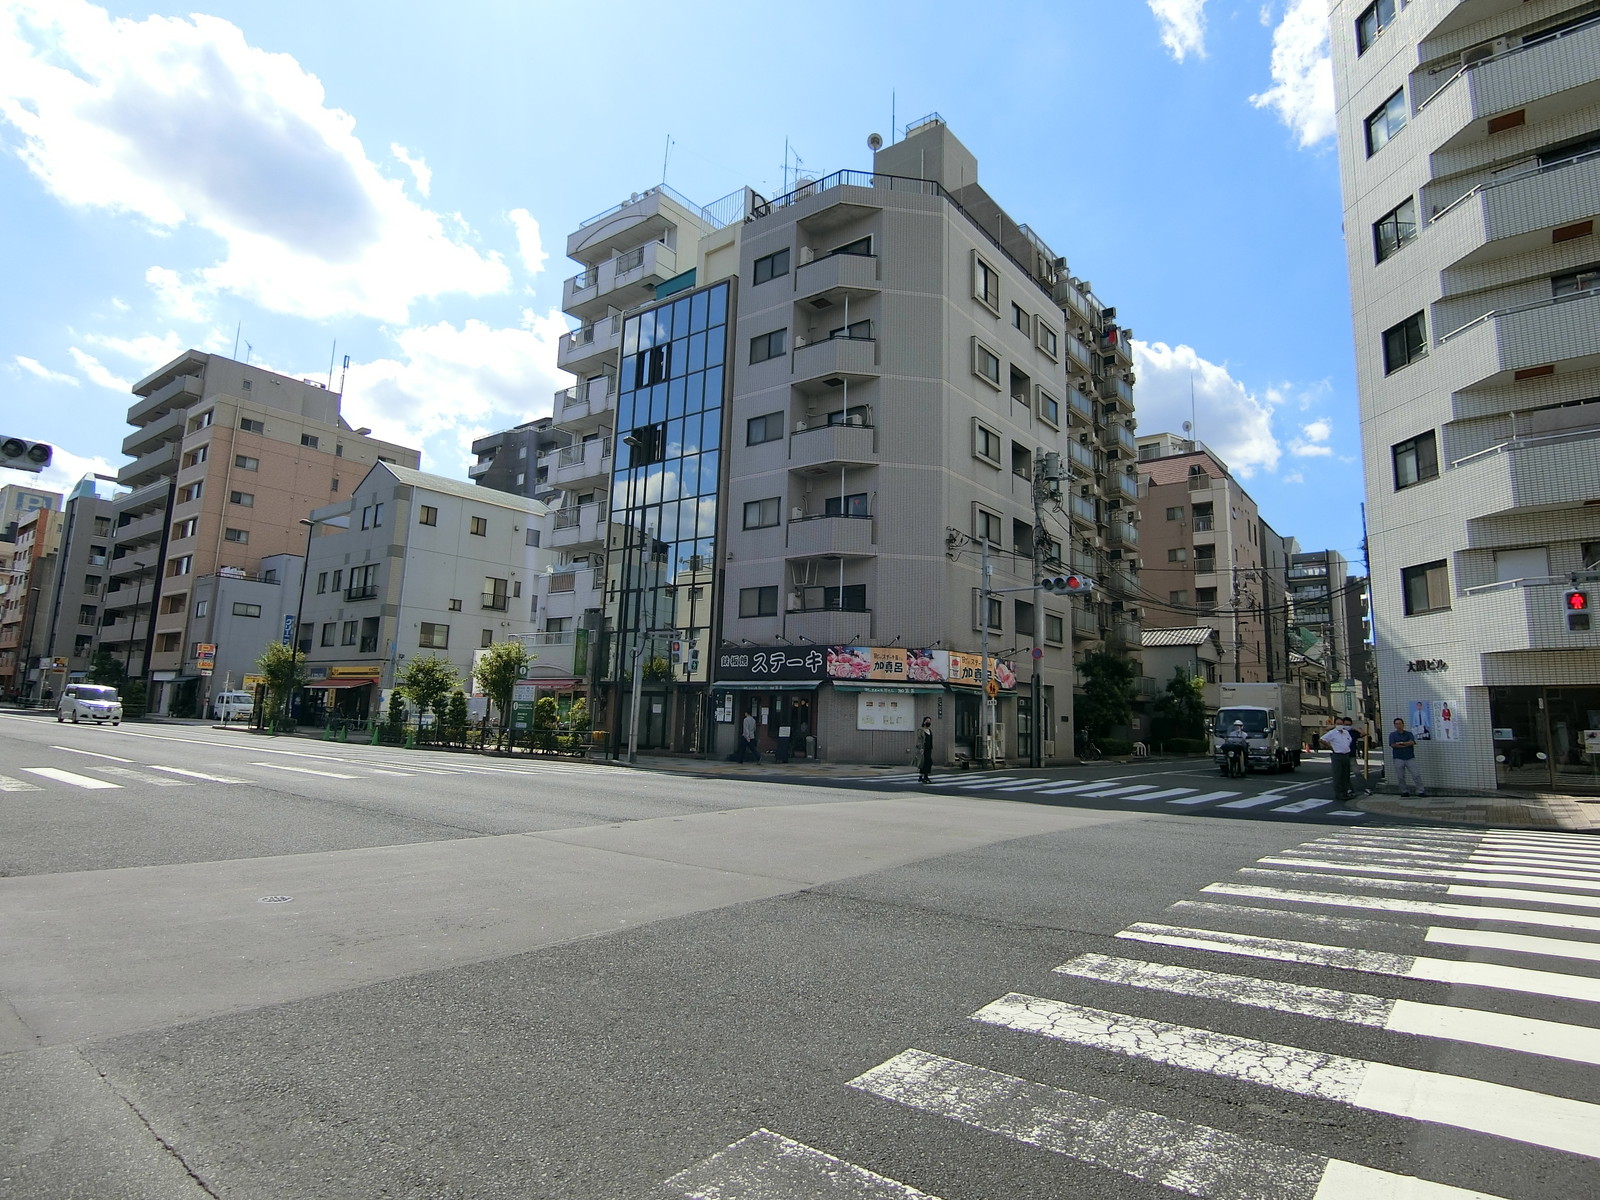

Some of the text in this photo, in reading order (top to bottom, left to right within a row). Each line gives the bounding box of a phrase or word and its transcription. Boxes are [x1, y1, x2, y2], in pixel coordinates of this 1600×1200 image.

[751, 650, 823, 674] ステーキ
[873, 660, 903, 673] 加真呂
